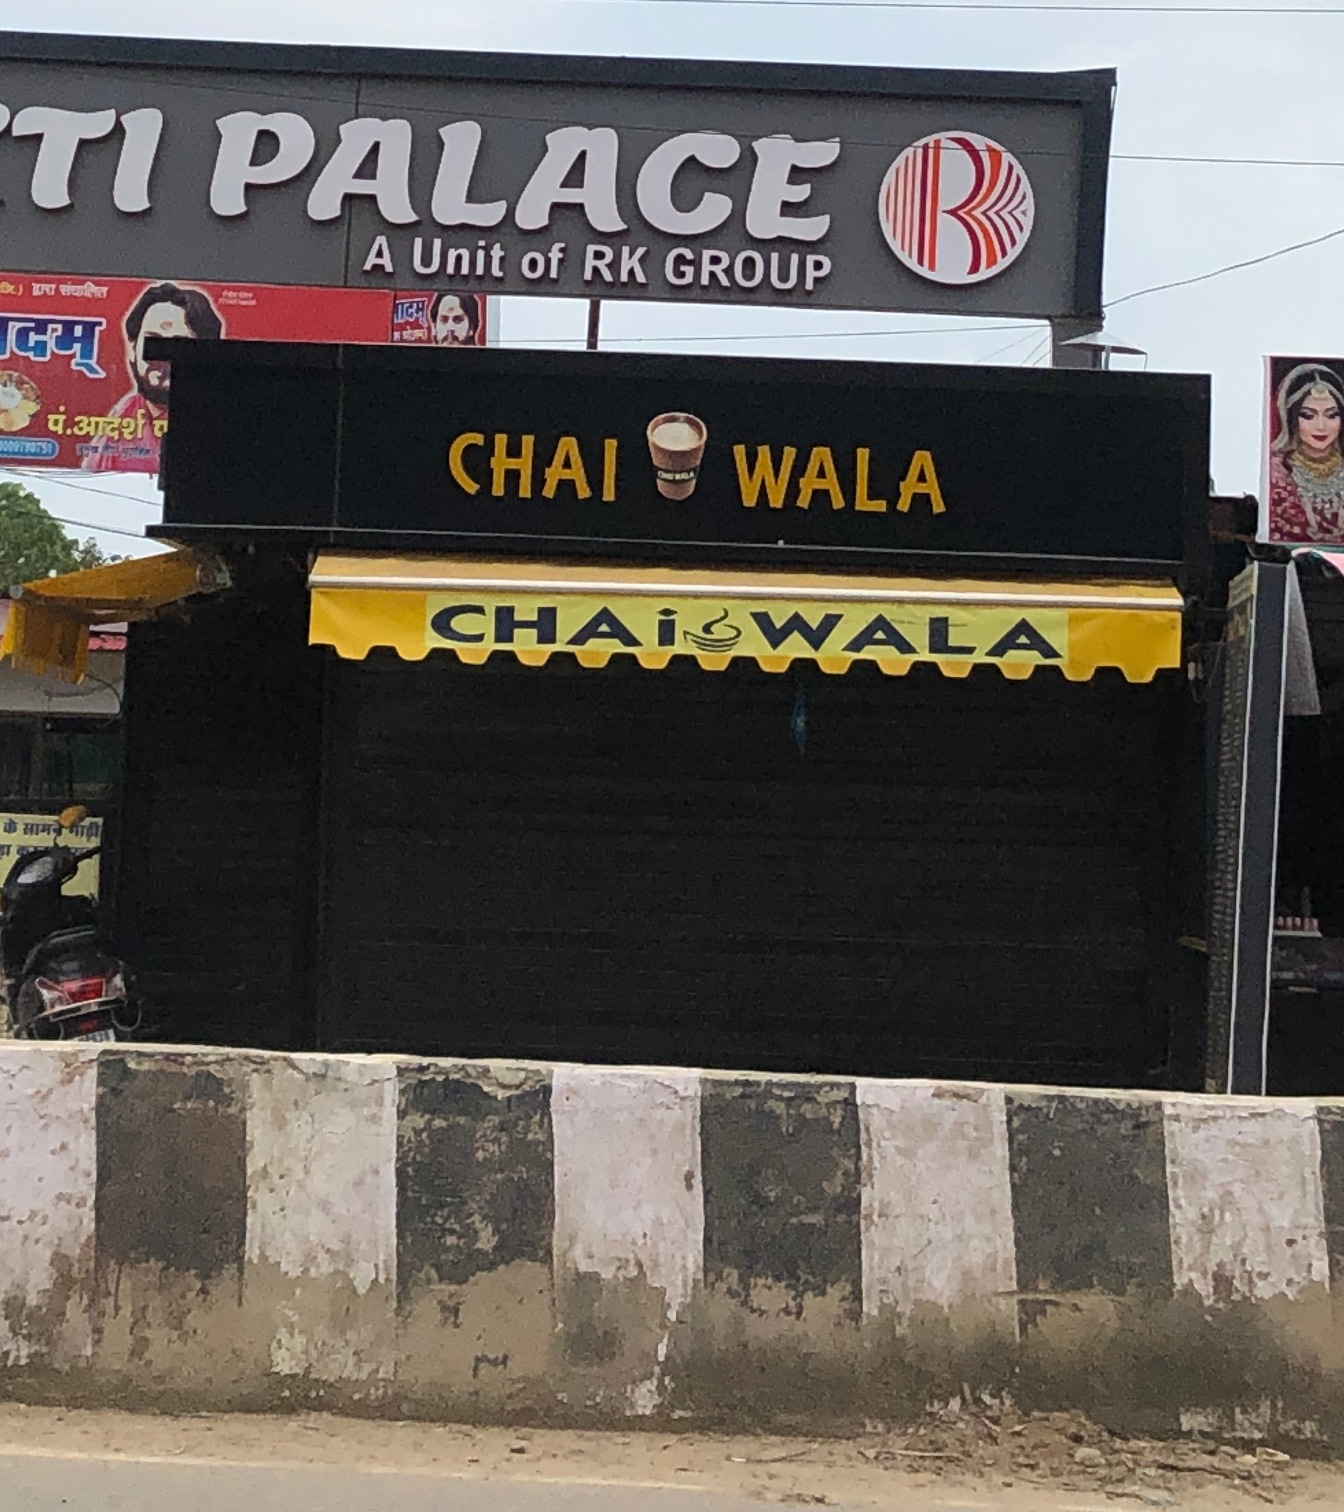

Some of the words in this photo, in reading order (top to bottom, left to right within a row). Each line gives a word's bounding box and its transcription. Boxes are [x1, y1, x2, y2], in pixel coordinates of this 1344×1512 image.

[209, 110, 843, 242] PALACE
[362, 235, 394, 274] A
[412, 236, 505, 278] Unit
[520, 242, 564, 280] of
[582, 243, 648, 285] RK
[664, 247, 833, 291] GROUP
[448, 431, 619, 503] CHAI
[733, 443, 947, 516] WALA
[749, 609, 1068, 660] WALA
